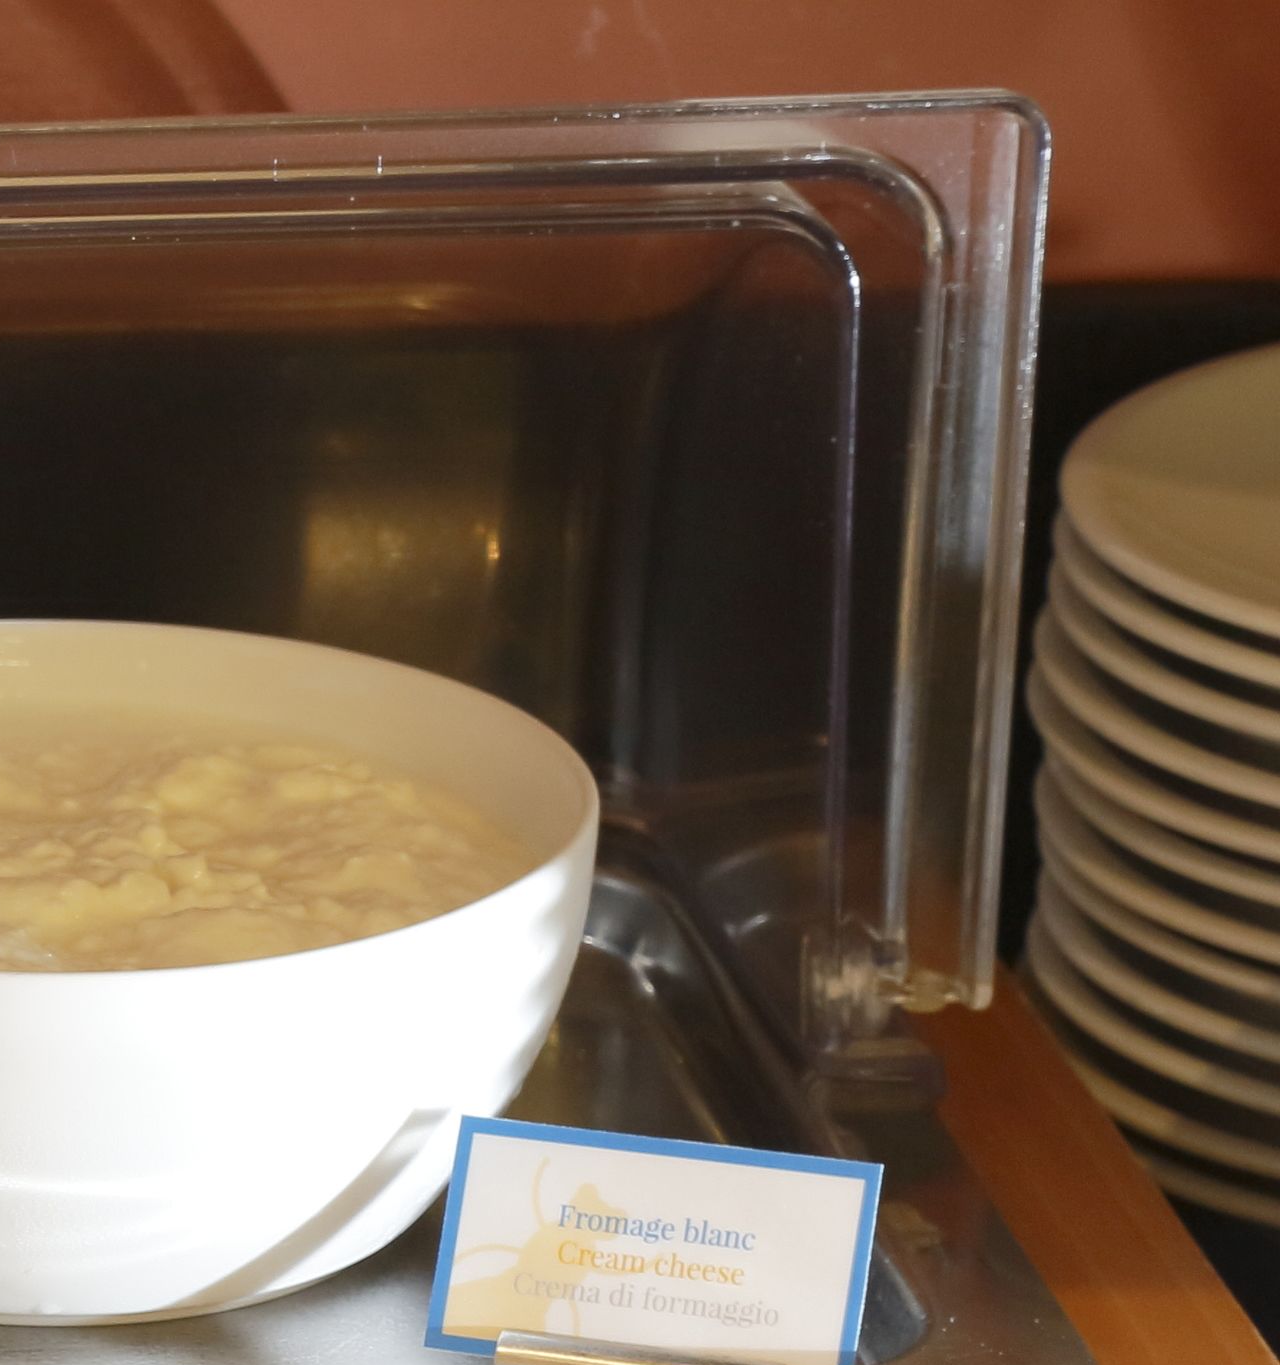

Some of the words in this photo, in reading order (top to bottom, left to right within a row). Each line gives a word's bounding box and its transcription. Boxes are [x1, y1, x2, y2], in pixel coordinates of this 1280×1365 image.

[558, 1204, 676, 1244] Fromage
[683, 1218, 757, 1252] blanc
[557, 1240, 646, 1273] Cream
[654, 1253, 745, 1286] cheese
[513, 1272, 600, 1305] Crema
[609, 1283, 634, 1308] di
[642, 1286, 779, 1329] formaggio
